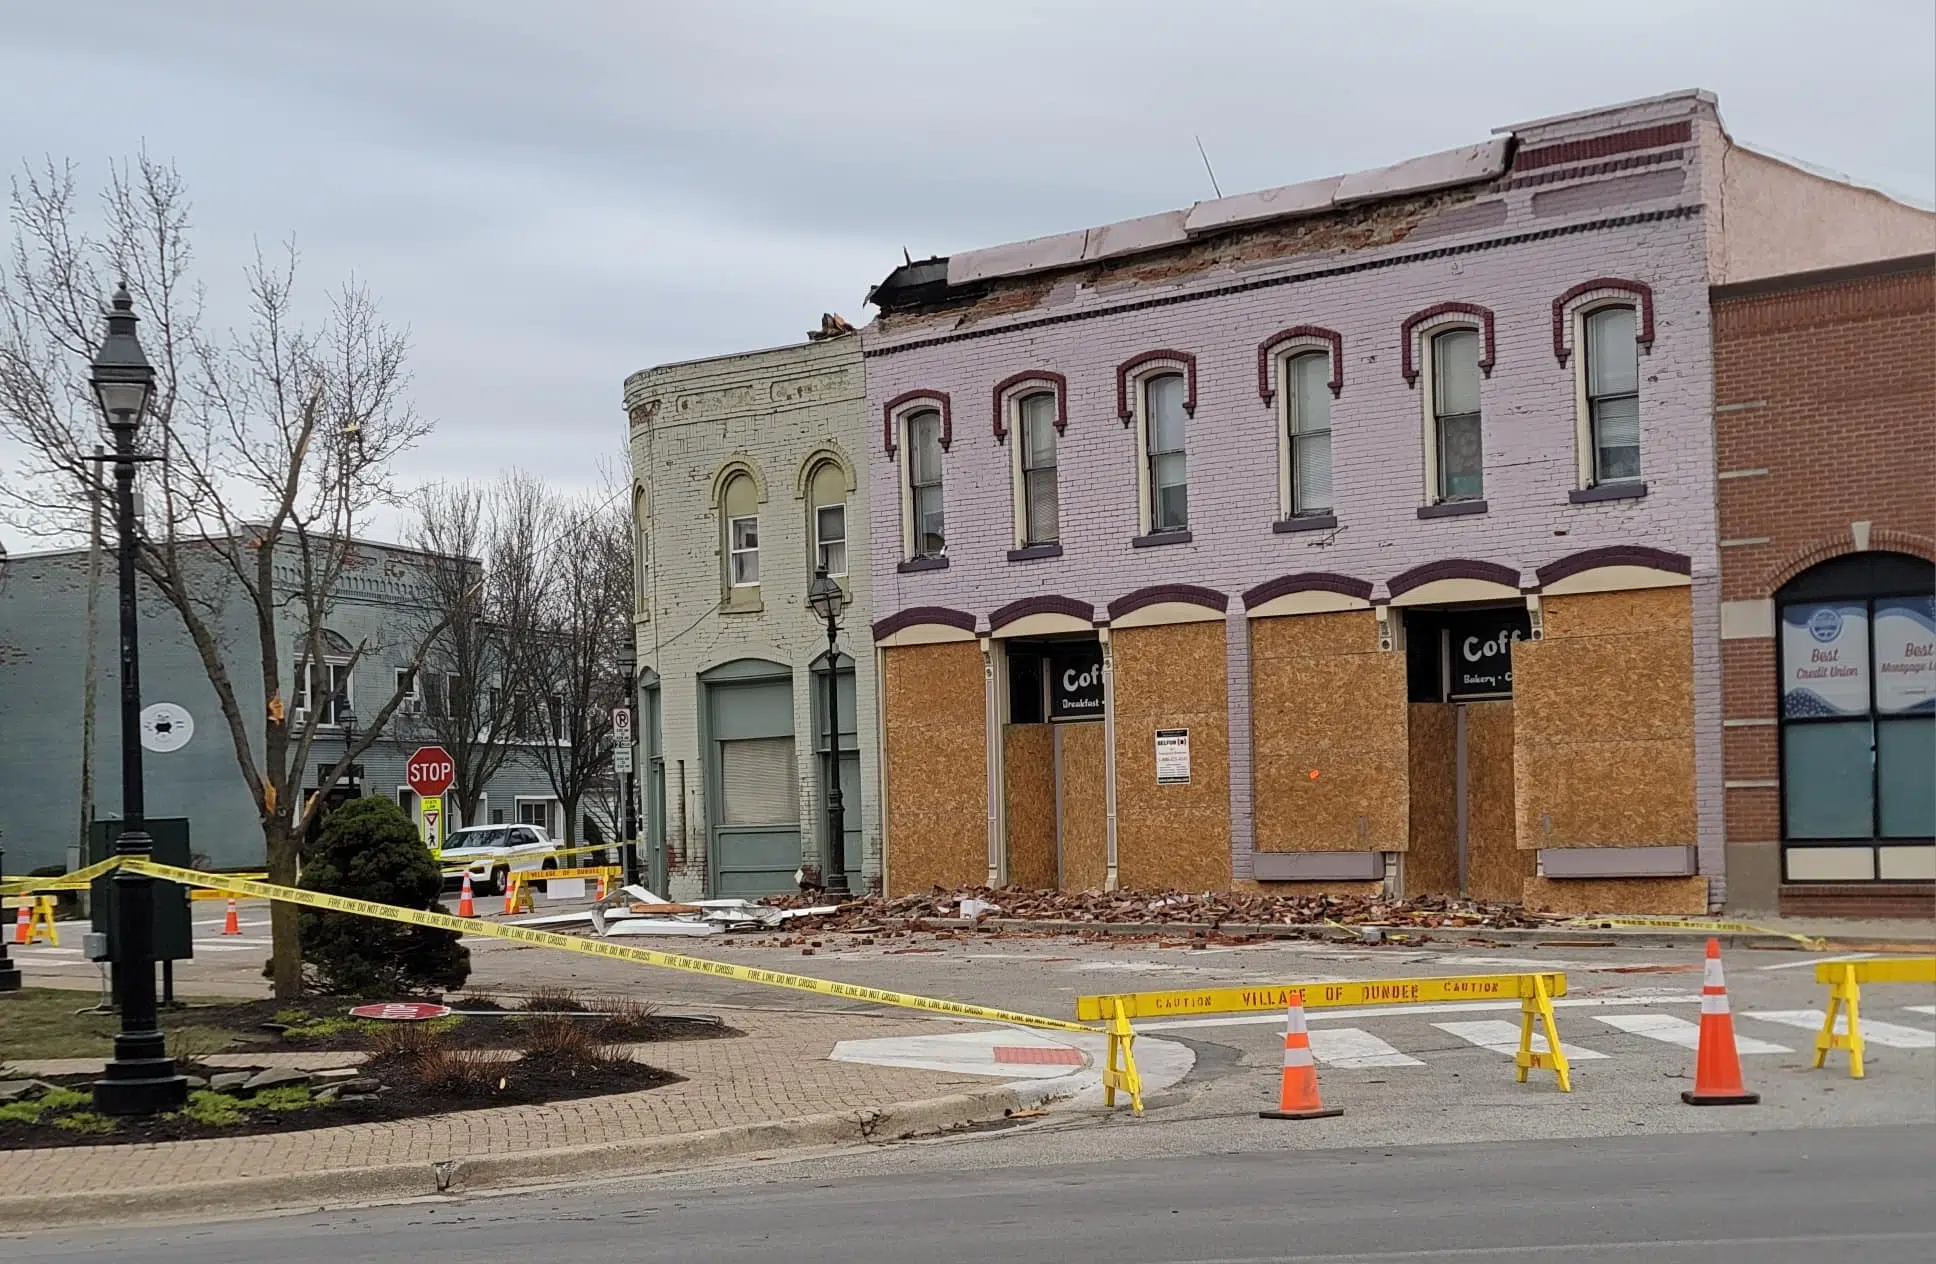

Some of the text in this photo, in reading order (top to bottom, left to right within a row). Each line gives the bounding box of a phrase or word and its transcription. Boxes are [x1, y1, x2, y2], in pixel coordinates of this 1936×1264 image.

[1811, 648, 1840, 663] Best
[1904, 642, 1935, 657] Best
[1463, 674, 1496, 686] Bakery
[1796, 666, 1858, 680] Credit Union
[1062, 698, 1099, 709] Breakfast
[410, 763, 451, 782] STOP
[328, 897, 400, 918] FIRE LINE DO NOT CROSS
[412, 911, 484, 932] FIRE LINE DO NOT CROSS
[497, 925, 568, 947] FIRE LINE DO NOT CROSS
[580, 940, 651, 961] FIRE LINE DO NOT CROSS
[664, 955, 735, 976] FIRE LINE DO NOT CROSS
[748, 969, 818, 989] FIRE LINE DO NOT CROSS
[830, 983, 901, 1003] FIRE LINE DO NOT CROSS
[1155, 995, 1212, 1009] CAUTION
[1325, 986, 1343, 1001] OF
[1361, 984, 1419, 1000] DUNDEE
[1444, 981, 1499, 993] CAUTION
